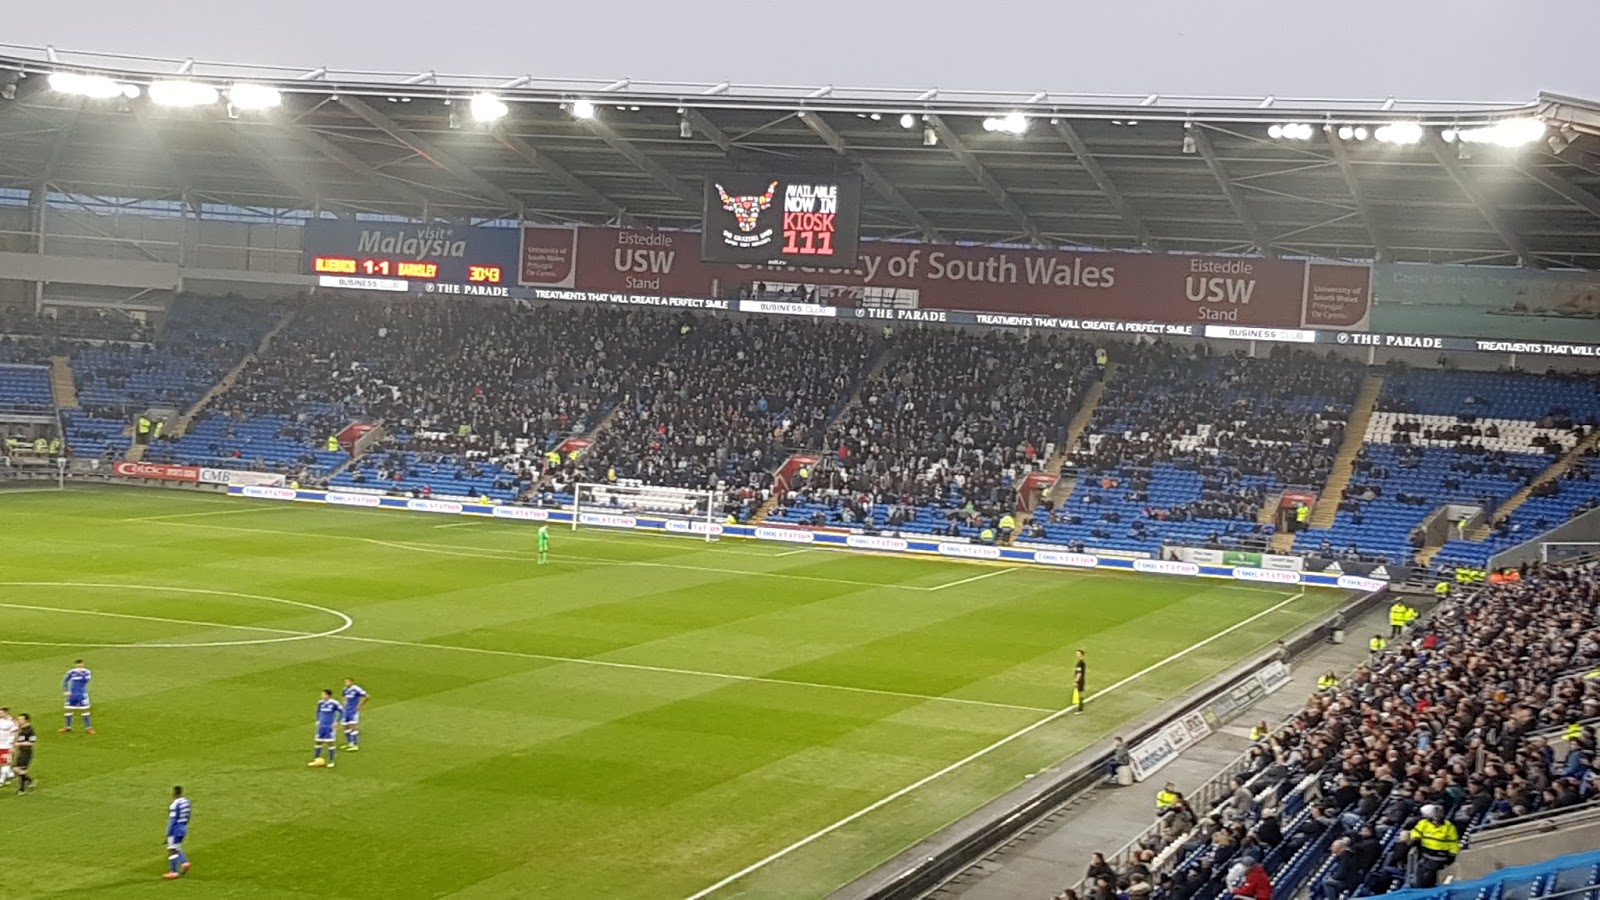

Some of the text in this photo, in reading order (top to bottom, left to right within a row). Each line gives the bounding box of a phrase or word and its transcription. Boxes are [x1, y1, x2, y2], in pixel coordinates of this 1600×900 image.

[787, 185, 837, 197] AVAILABLE
[784, 197, 837, 213] NOW IN
[784, 212, 835, 232] KIOSK
[418, 228, 444, 240] visit
[619, 231, 673, 247] Eisteddle
[358, 230, 466, 261] Malaysia
[782, 231, 834, 255] 111
[614, 248, 675, 274] USW
[887, 250, 921, 278] of
[927, 252, 1017, 284] South
[1024, 256, 1115, 288] Wales
[1190, 259, 1253, 275] Eisteddle
[437, 283, 460, 294] THE
[464, 285, 509, 297] PARADE
[625, 276, 660, 290] Stand
[1185, 275, 1256, 304] USW
[535, 290, 729, 309] TREATMENTS THAT WILL CREATE A PERFECT SMILE
[868, 308, 893, 319] THE
[897, 309, 947, 322] PARADE
[1198, 306, 1238, 321] Stand
[976, 314, 1192, 335] TREATMENTS THAT WILL CREATE A PERFECT SMILE
[1229, 328, 1276, 339] BUSINESS
[1351, 334, 1381, 346] THE
[1386, 335, 1443, 349] PARADE
[1476, 340, 1541, 354] TREATMENTS
[1543, 344, 1569, 355] THAT
[1570, 345, 1595, 357] WILL
